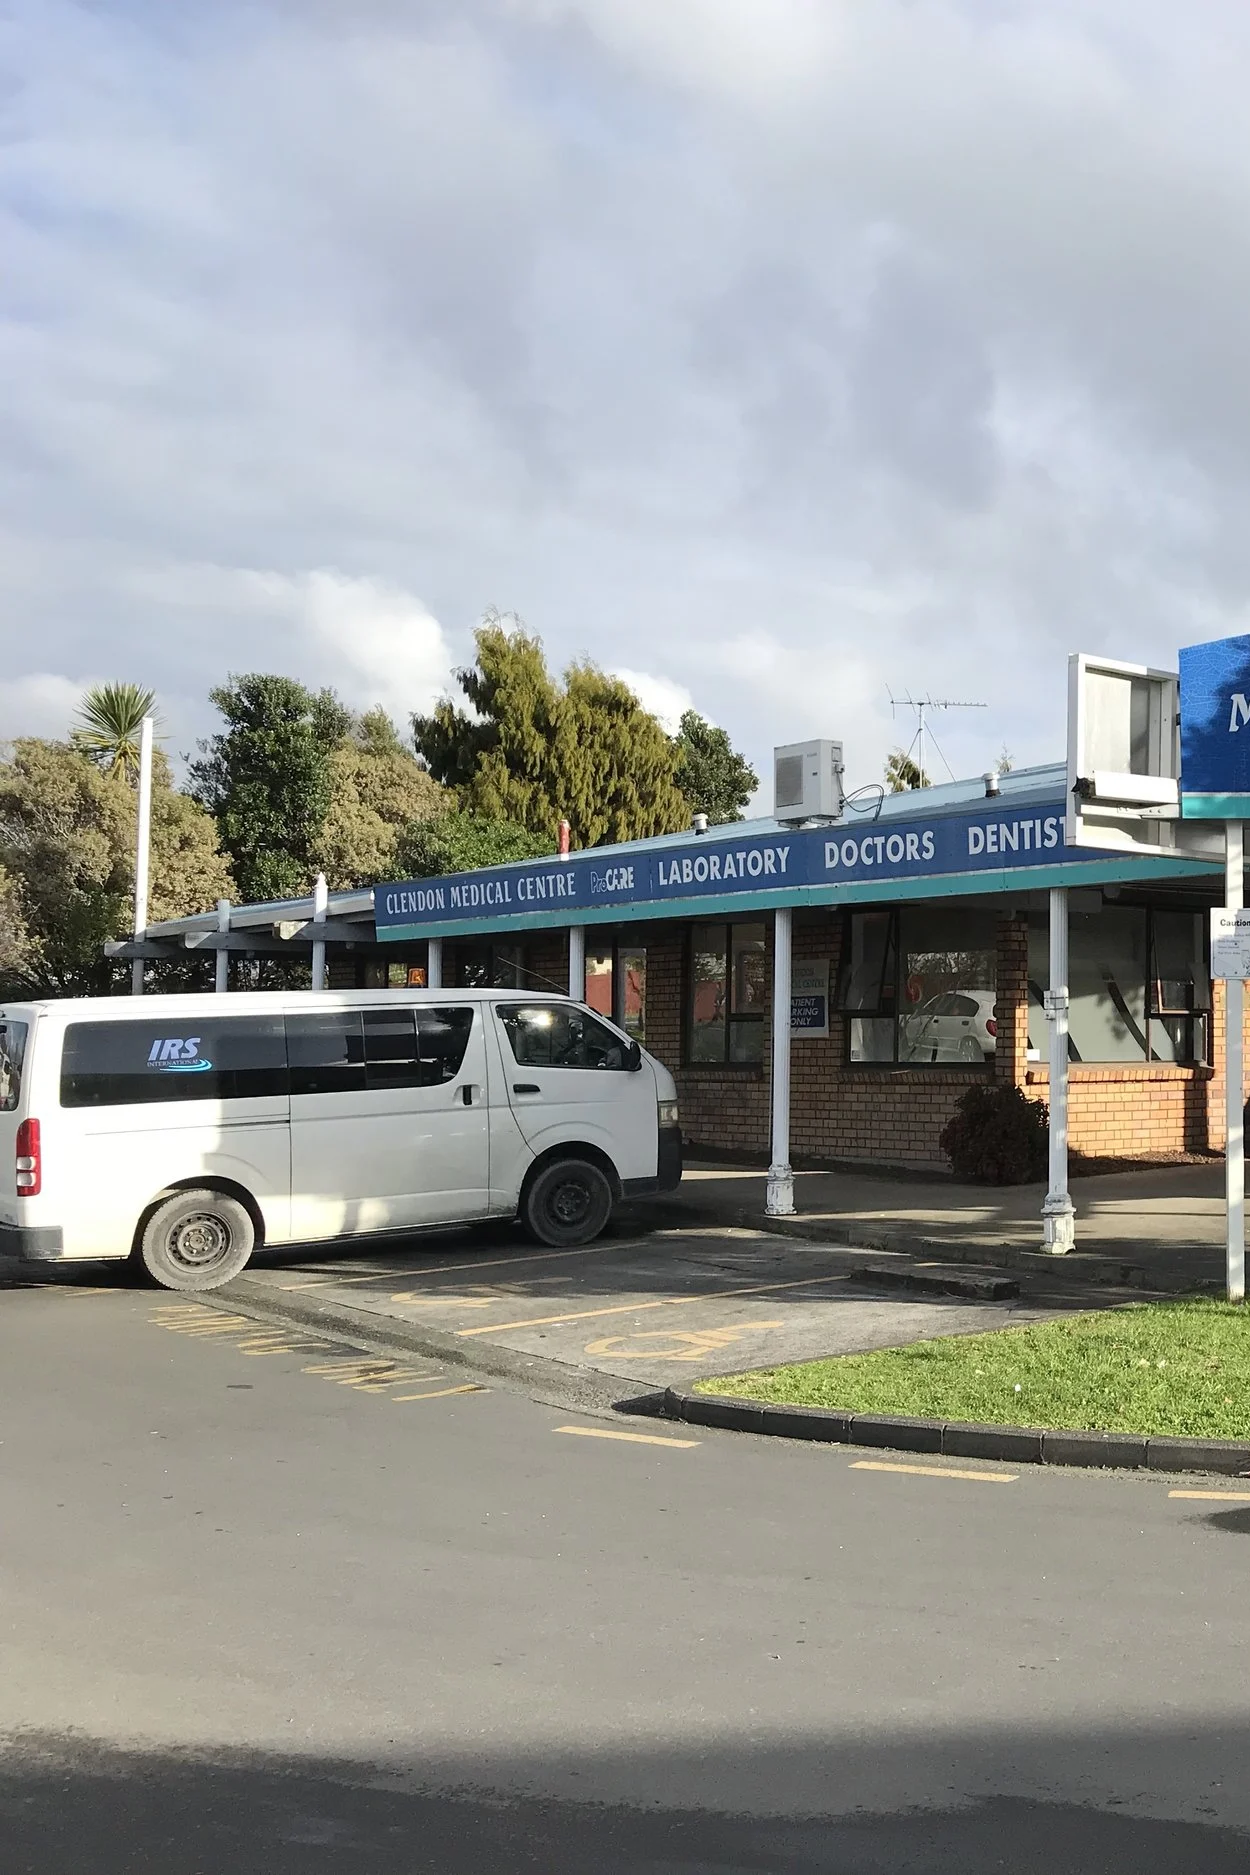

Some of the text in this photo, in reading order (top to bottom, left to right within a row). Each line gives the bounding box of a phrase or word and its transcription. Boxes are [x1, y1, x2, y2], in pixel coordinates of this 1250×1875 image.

[658, 846, 790, 886] LABORATORY
[825, 831, 935, 869] DOCTORS
[386, 872, 576, 915] CLENDON MEDICAL CENTRE
[791, 1007, 819, 1016] RKING
[148, 1037, 202, 1061] IRS
